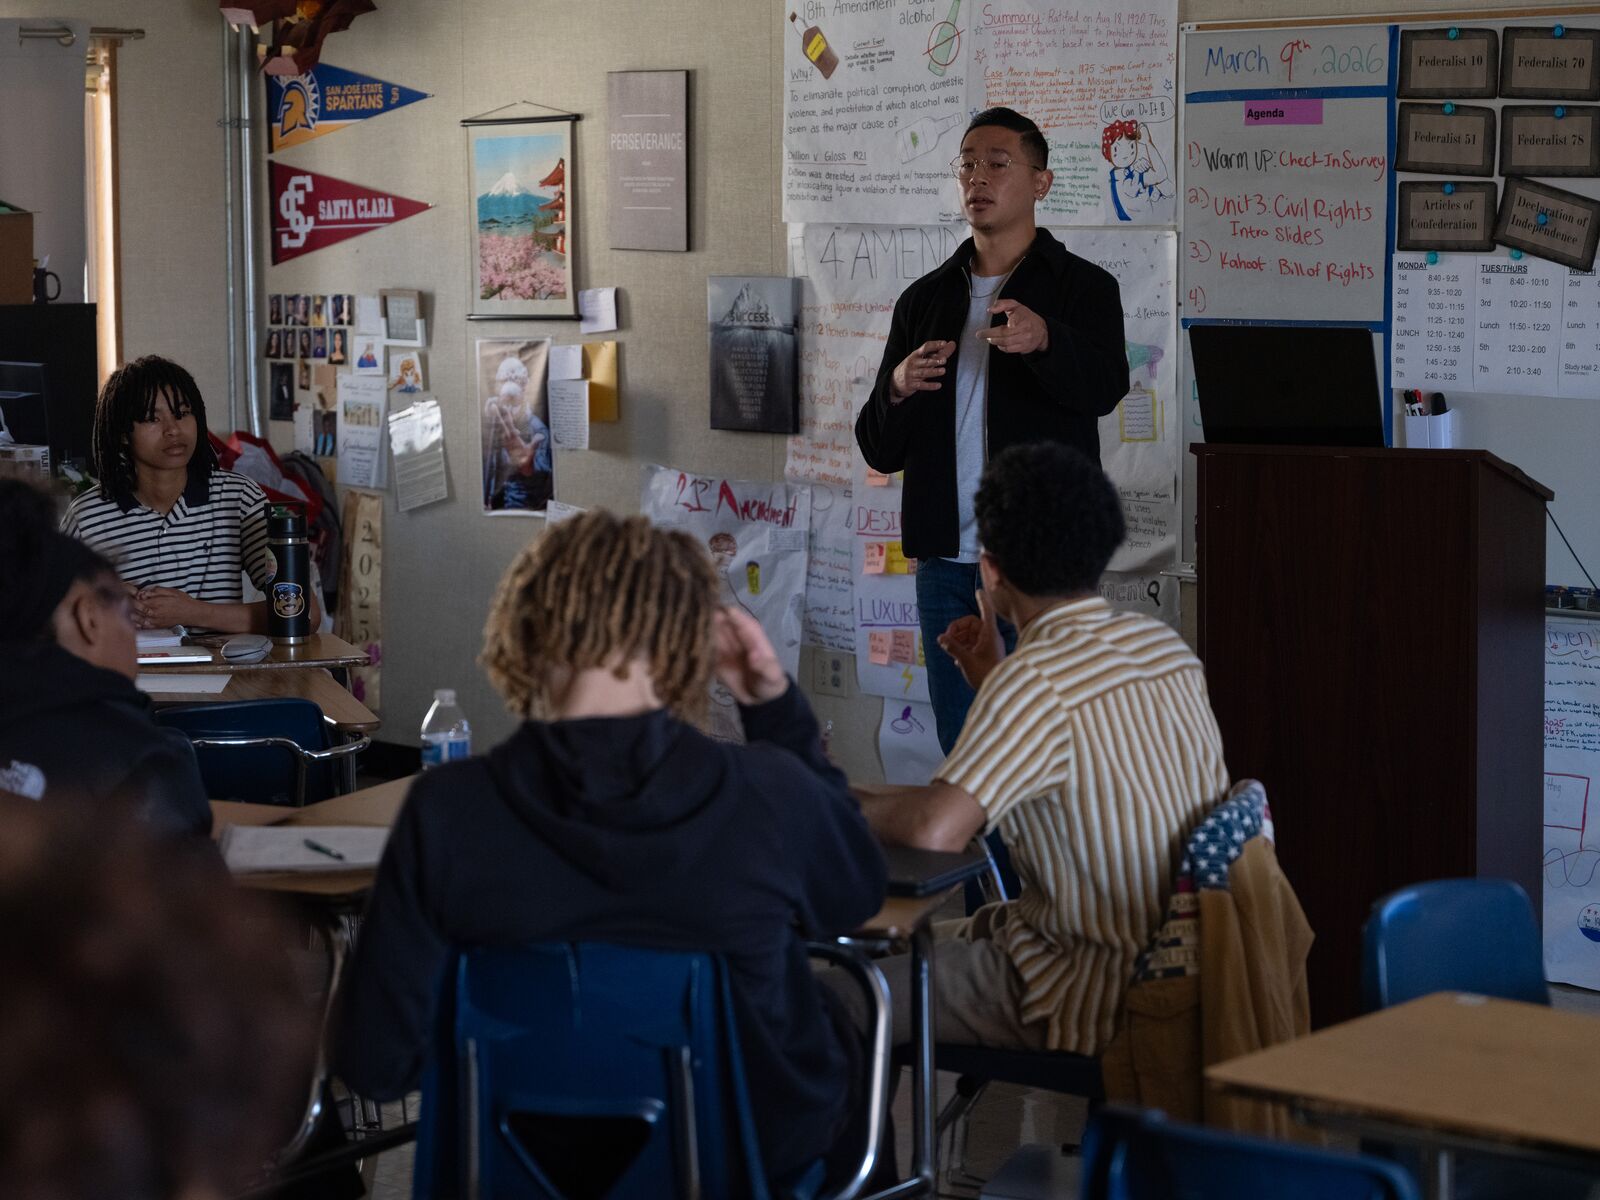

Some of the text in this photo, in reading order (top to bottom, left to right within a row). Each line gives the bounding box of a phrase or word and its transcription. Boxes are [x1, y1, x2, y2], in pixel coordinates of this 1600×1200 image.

[900, 8, 935, 25] alcohol
[1095, 11, 1111, 25] Aug
[1149, 12, 1167, 25] This
[1205, 45, 1270, 76] March
[1418, 55, 1483, 68] Federalist 10
[1518, 55, 1585, 70] Federalist 70
[790, 67, 813, 81] Why?
[326, 86, 340, 96] SAN
[362, 83, 384, 95] STATE
[790, 89, 799, 102] To
[847, 85, 879, 102] political
[930, 78, 963, 91] domestic
[326, 94, 384, 111] SPARTANS
[820, 108, 833, 116] and
[876, 101, 883, 111] of
[885, 101, 906, 111] which
[909, 98, 940, 110] alcohol
[944, 95, 959, 104] was
[1104, 104, 1118, 119] We
[1121, 103, 1135, 118] Can
[1247, 108, 1284, 120] Agenda
[810, 125, 819, 133] as
[823, 122, 834, 132] the
[836, 122, 857, 135] major
[861, 120, 885, 130] cause
[888, 116, 899, 128] of
[610, 132, 683, 151] PERSEVERANCE
[1414, 131, 1477, 145] Federalist 51
[1517, 133, 1584, 146] Federalist 78
[1203, 147, 1249, 172] Warm
[1342, 149, 1386, 181] Survey
[318, 197, 395, 221] SANTA CLARA
[1422, 198, 1474, 211] Articles of
[1214, 194, 1251, 217] Unit
[1274, 194, 1309, 222] Civil
[1313, 198, 1373, 229] Rights
[1517, 195, 1589, 228] Declaration of
[1411, 218, 1478, 231] Confederation
[1510, 214, 1579, 245] Independence
[1229, 220, 1325, 246] Intro Slides
[1397, 261, 1427, 270] MONDAY
[1481, 264, 1528, 274] TUES/THURS
[1278, 258, 1305, 277] Bill
[1307, 262, 1322, 277] of
[1327, 262, 1375, 287] Rights
[1481, 277, 1549, 287] 1st 8:40 10:10
[1568, 279, 1581, 287] 2nd
[1480, 299, 1552, 309] 3rd 10:20 11:50
[1567, 300, 1578, 308] 4th
[729, 311, 770, 323] SUCCESS
[1479, 321, 1551, 332] Lunch 11:50 12:20
[1566, 321, 1586, 329] Lunch
[1396, 329, 1465, 339] LUNCH 12:10 12:40
[1479, 343, 1546, 354] 5th 12:30 2:00
[1565, 342, 1576, 350] 6th
[1479, 365, 1542, 376] 7th 2:10 3:40
[1564, 363, 1592, 372] Study Hall
